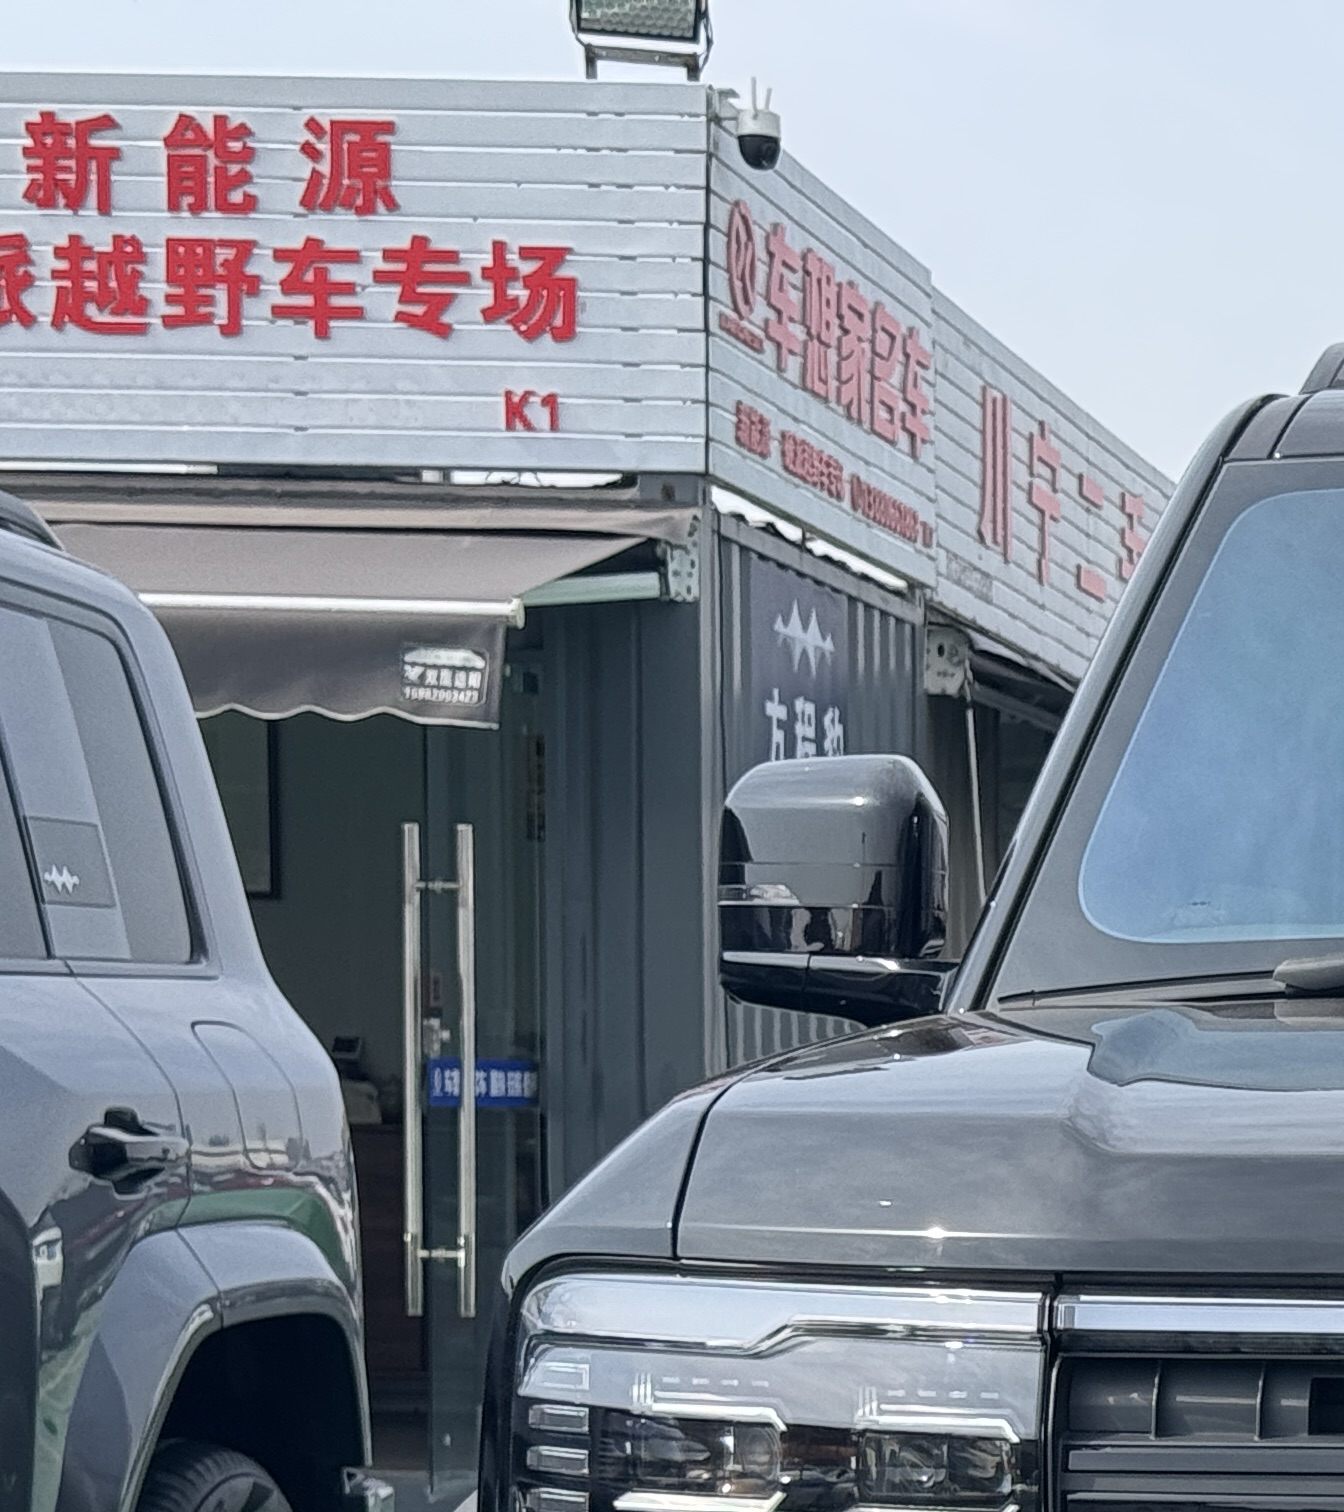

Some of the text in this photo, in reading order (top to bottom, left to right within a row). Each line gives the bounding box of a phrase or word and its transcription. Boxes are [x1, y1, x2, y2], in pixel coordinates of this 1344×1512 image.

[22, 111, 400, 216] 新能源
[765, 222, 931, 460] 车想家名车
[503, 389, 560, 433] K1
